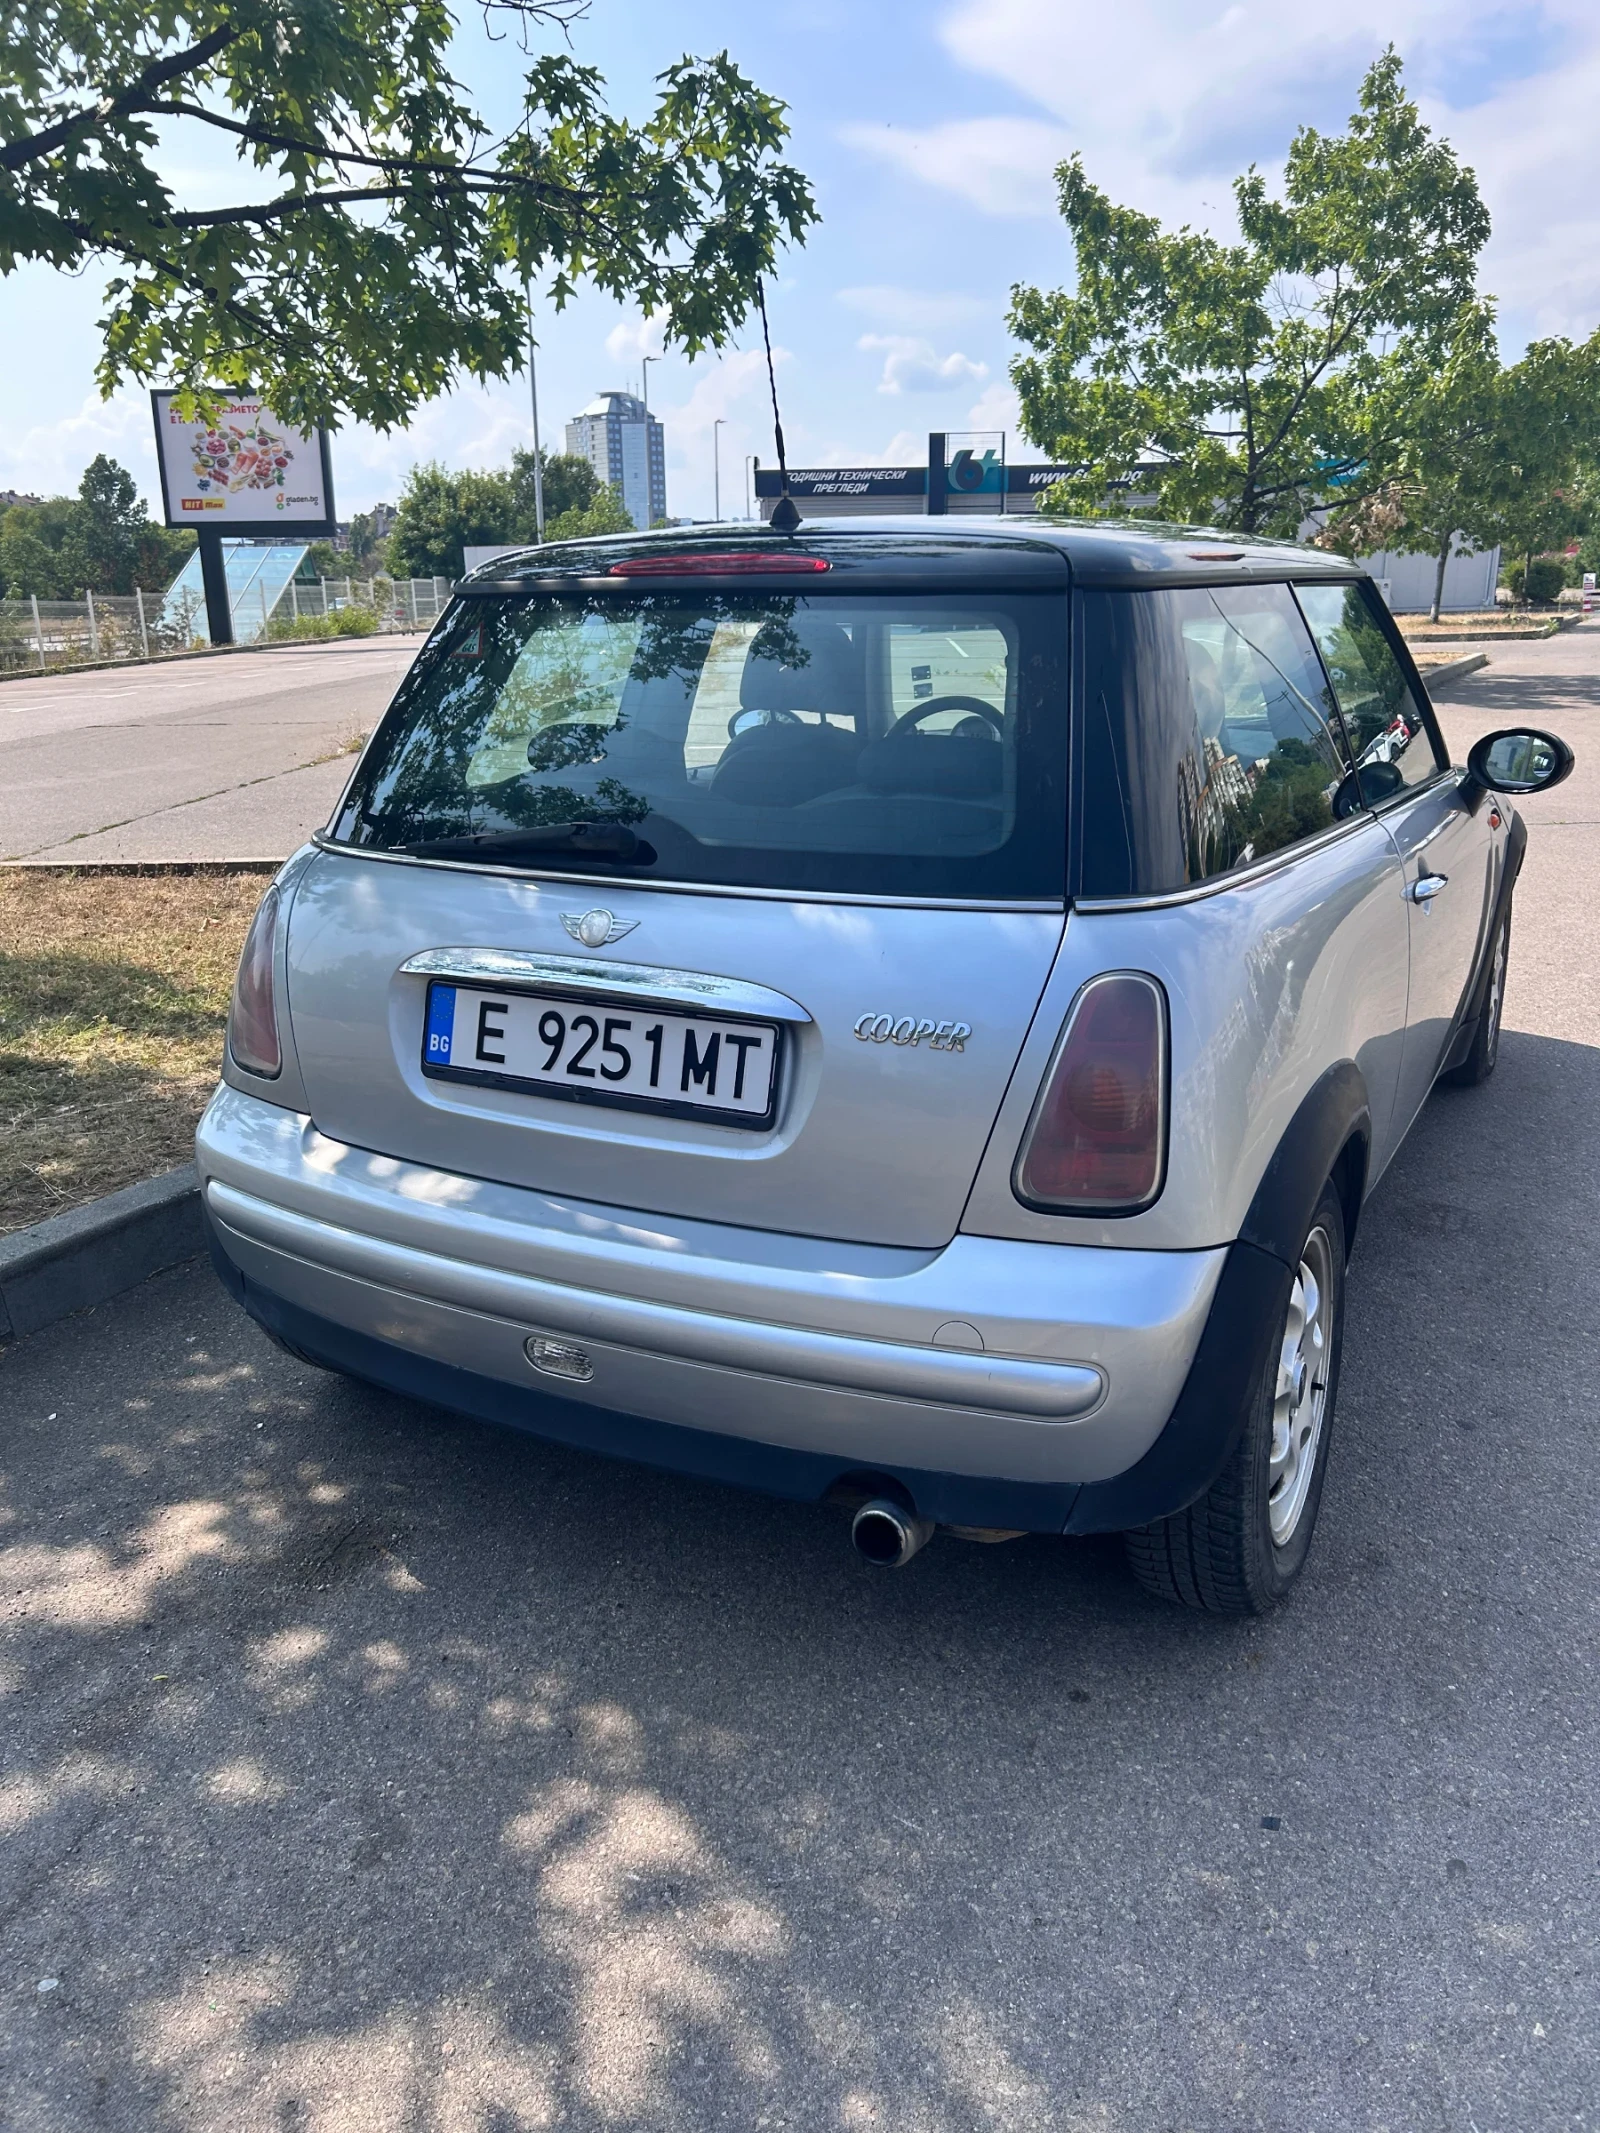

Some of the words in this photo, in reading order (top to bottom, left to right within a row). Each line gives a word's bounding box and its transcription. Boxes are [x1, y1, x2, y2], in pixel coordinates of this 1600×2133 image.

[838, 471, 907, 481] ТЕХНИЧЕСКИ
[812, 483, 870, 494] ПРЕГЛЕДИ
[185, 500, 201, 509] HIT
[429, 1033, 450, 1053] BG
[476, 1001, 508, 1064] E
[853, 1011, 972, 1052] COOPER
